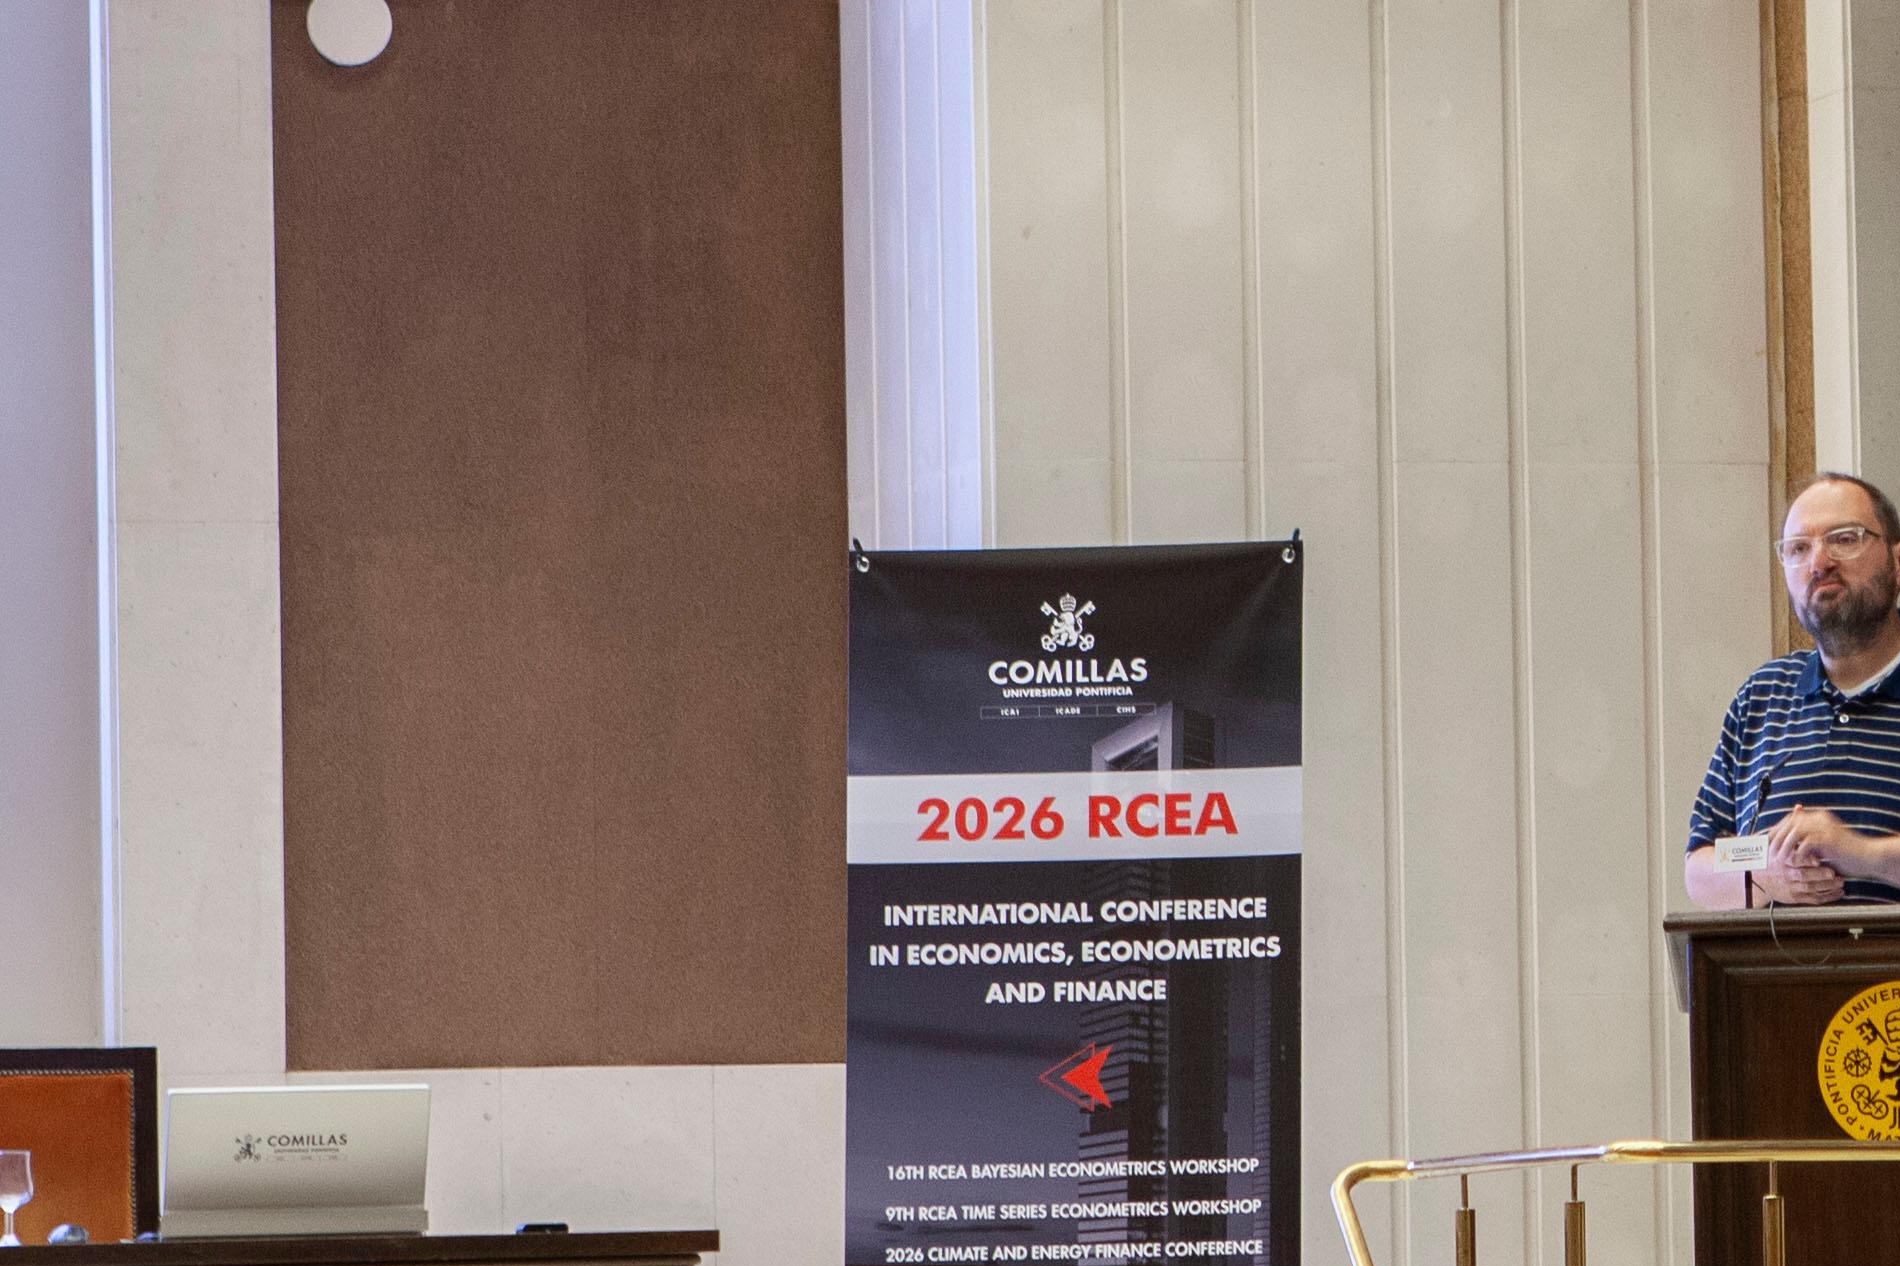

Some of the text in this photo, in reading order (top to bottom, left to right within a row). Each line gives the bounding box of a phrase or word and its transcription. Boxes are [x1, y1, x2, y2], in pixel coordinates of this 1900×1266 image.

[988, 658, 1148, 685] COMILLAS
[1002, 685, 1134, 699] UNIVERSIDAD PONTIFICIA
[917, 792, 1239, 842] 2026 RCEA
[884, 896, 1267, 927] INTERNATIONAL CONFERENCE
[869, 935, 1282, 966] IN ECONOMICS, ECONOMETRICS
[985, 979, 1167, 1004] AND FINANCE
[1824, 1029, 1858, 1126] PONTIFICIA
[267, 1133, 348, 1148] COMILLAS
[887, 1157, 1260, 1181] 16TH RCEA BAYESIAN ECONOMETRICS WORKSHOP
[885, 1198, 1262, 1222] 9TH RCEA TIME SERIES ECONOMETRICS WORKSHOP
[885, 1239, 1263, 1263] 2026 CLIMATE AND ENERGY FINANCE CONFERENCE
